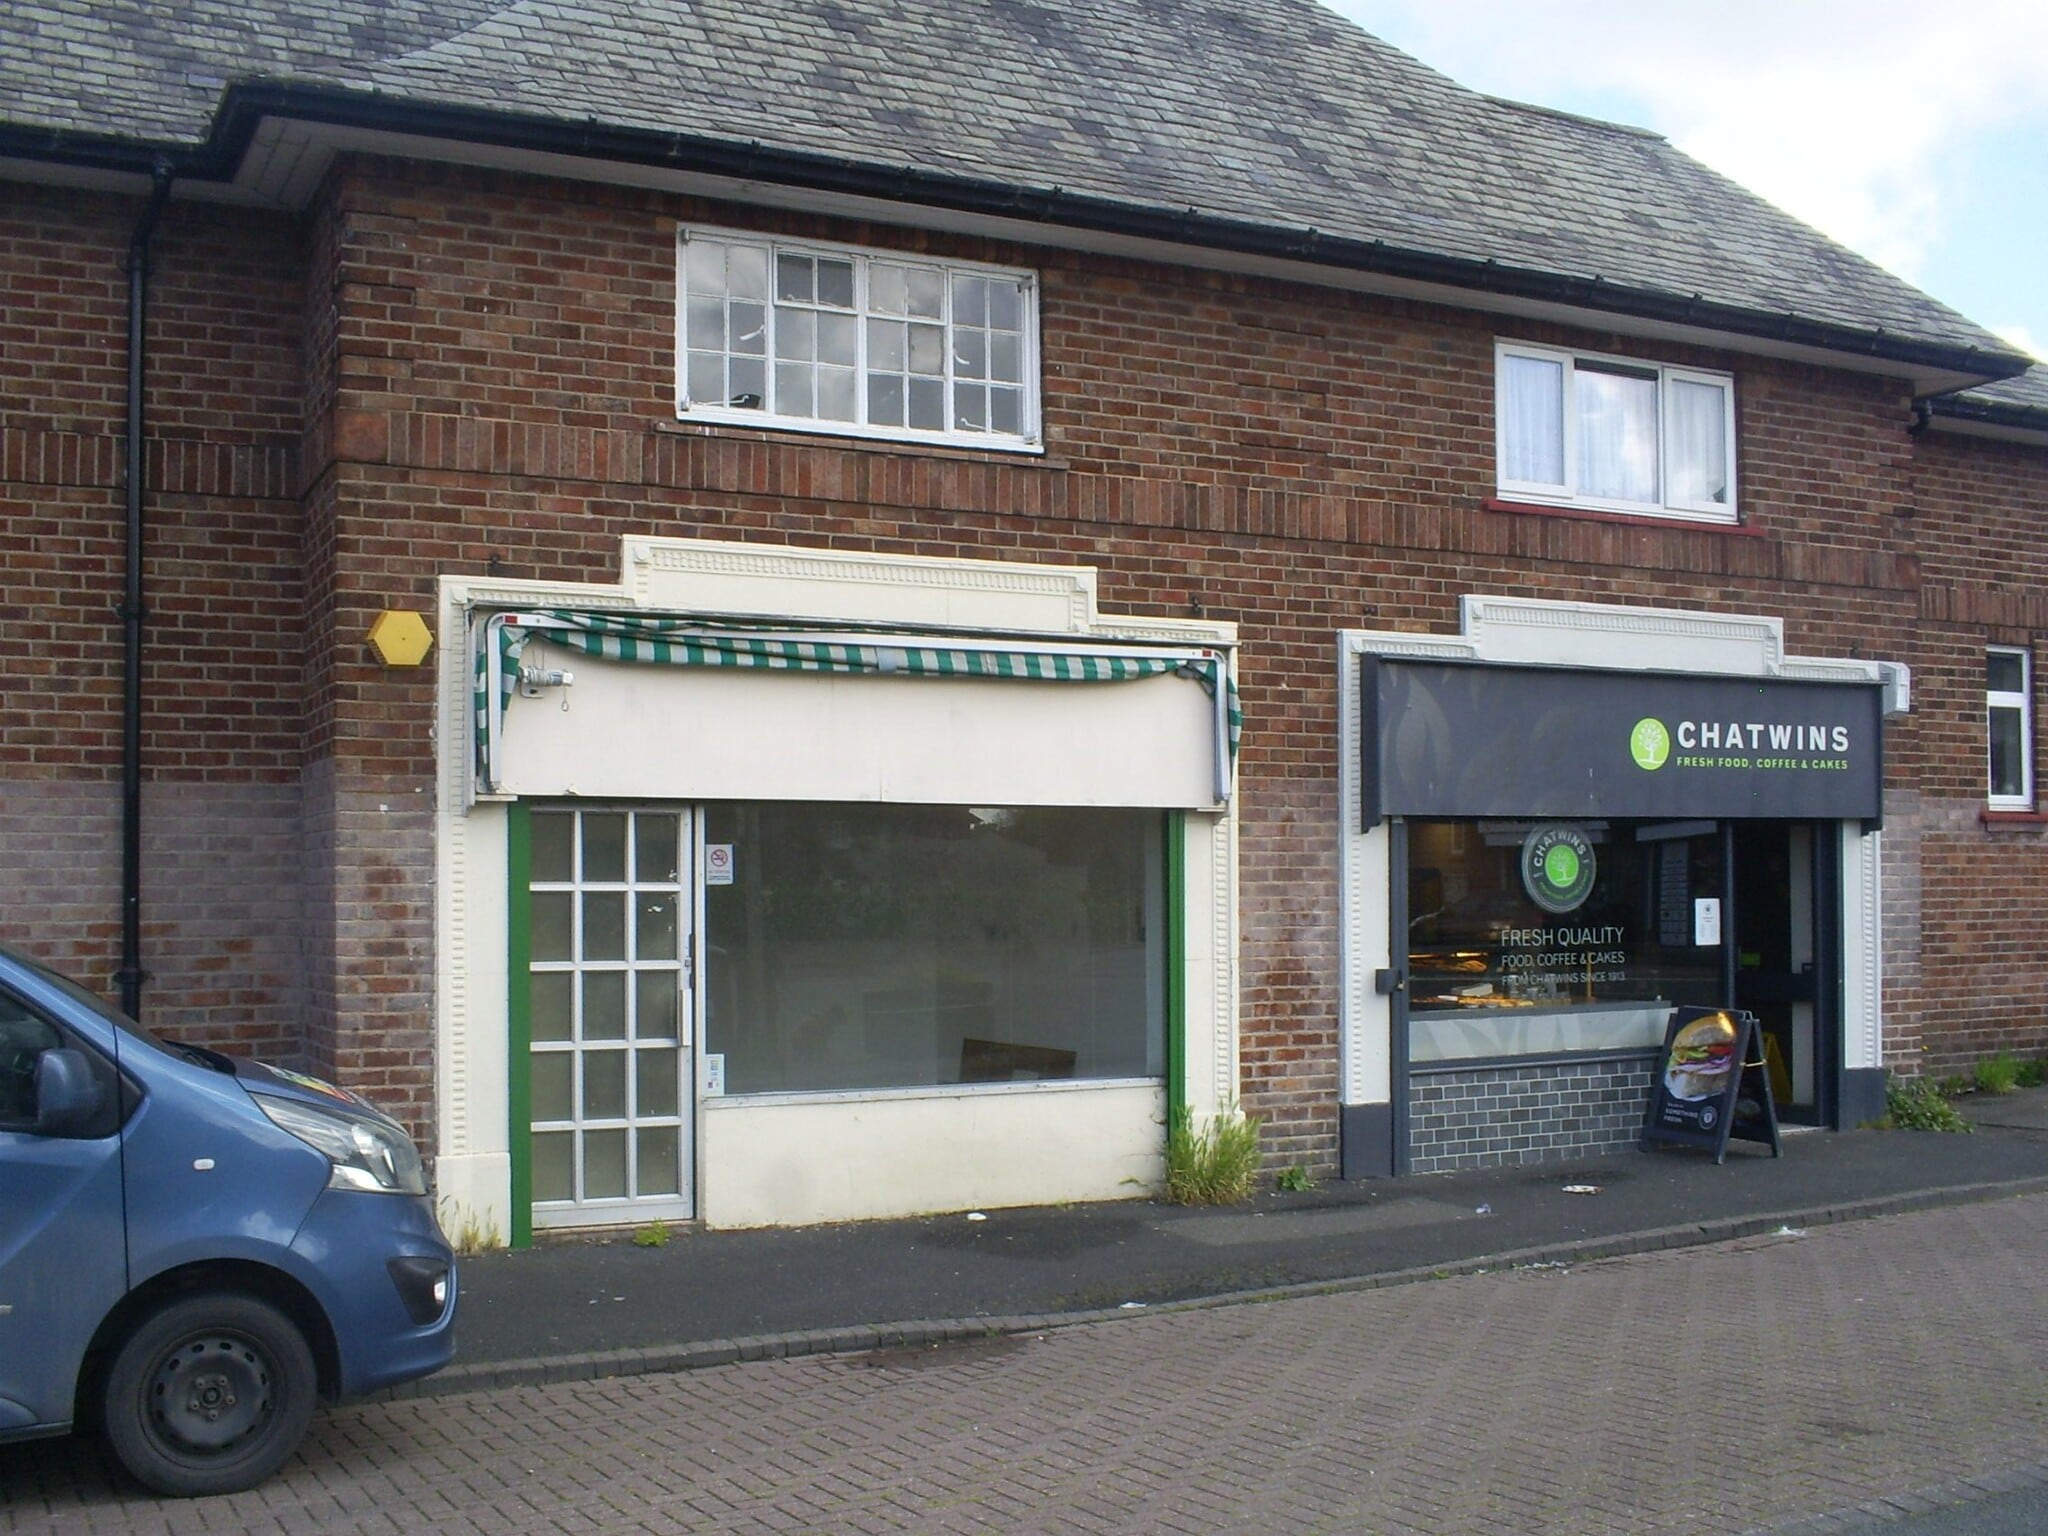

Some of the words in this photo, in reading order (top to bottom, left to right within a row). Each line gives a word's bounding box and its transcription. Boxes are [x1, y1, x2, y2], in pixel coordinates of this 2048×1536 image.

[1677, 721, 1849, 752] CHATWINS
[1677, 757, 1714, 768] FRESH
[1718, 757, 1752, 769] FOOD,
[1756, 758, 1797, 769] COFFEE
[1801, 760, 1808, 769] &
[1812, 760, 1848, 770] CAKES
[1534, 831, 1587, 867] CHATWINS
[1501, 928, 1554, 947] FRESH
[1557, 927, 1624, 947] QUALITY
[1537, 952, 1577, 967] COFFEE
[1580, 954, 1587, 965] &
[1588, 951, 1625, 964] CAKES
[1502, 974, 1529, 986] FROM
[1530, 971, 1579, 985] CHATWINS
[1581, 971, 1606, 983] SINCE
